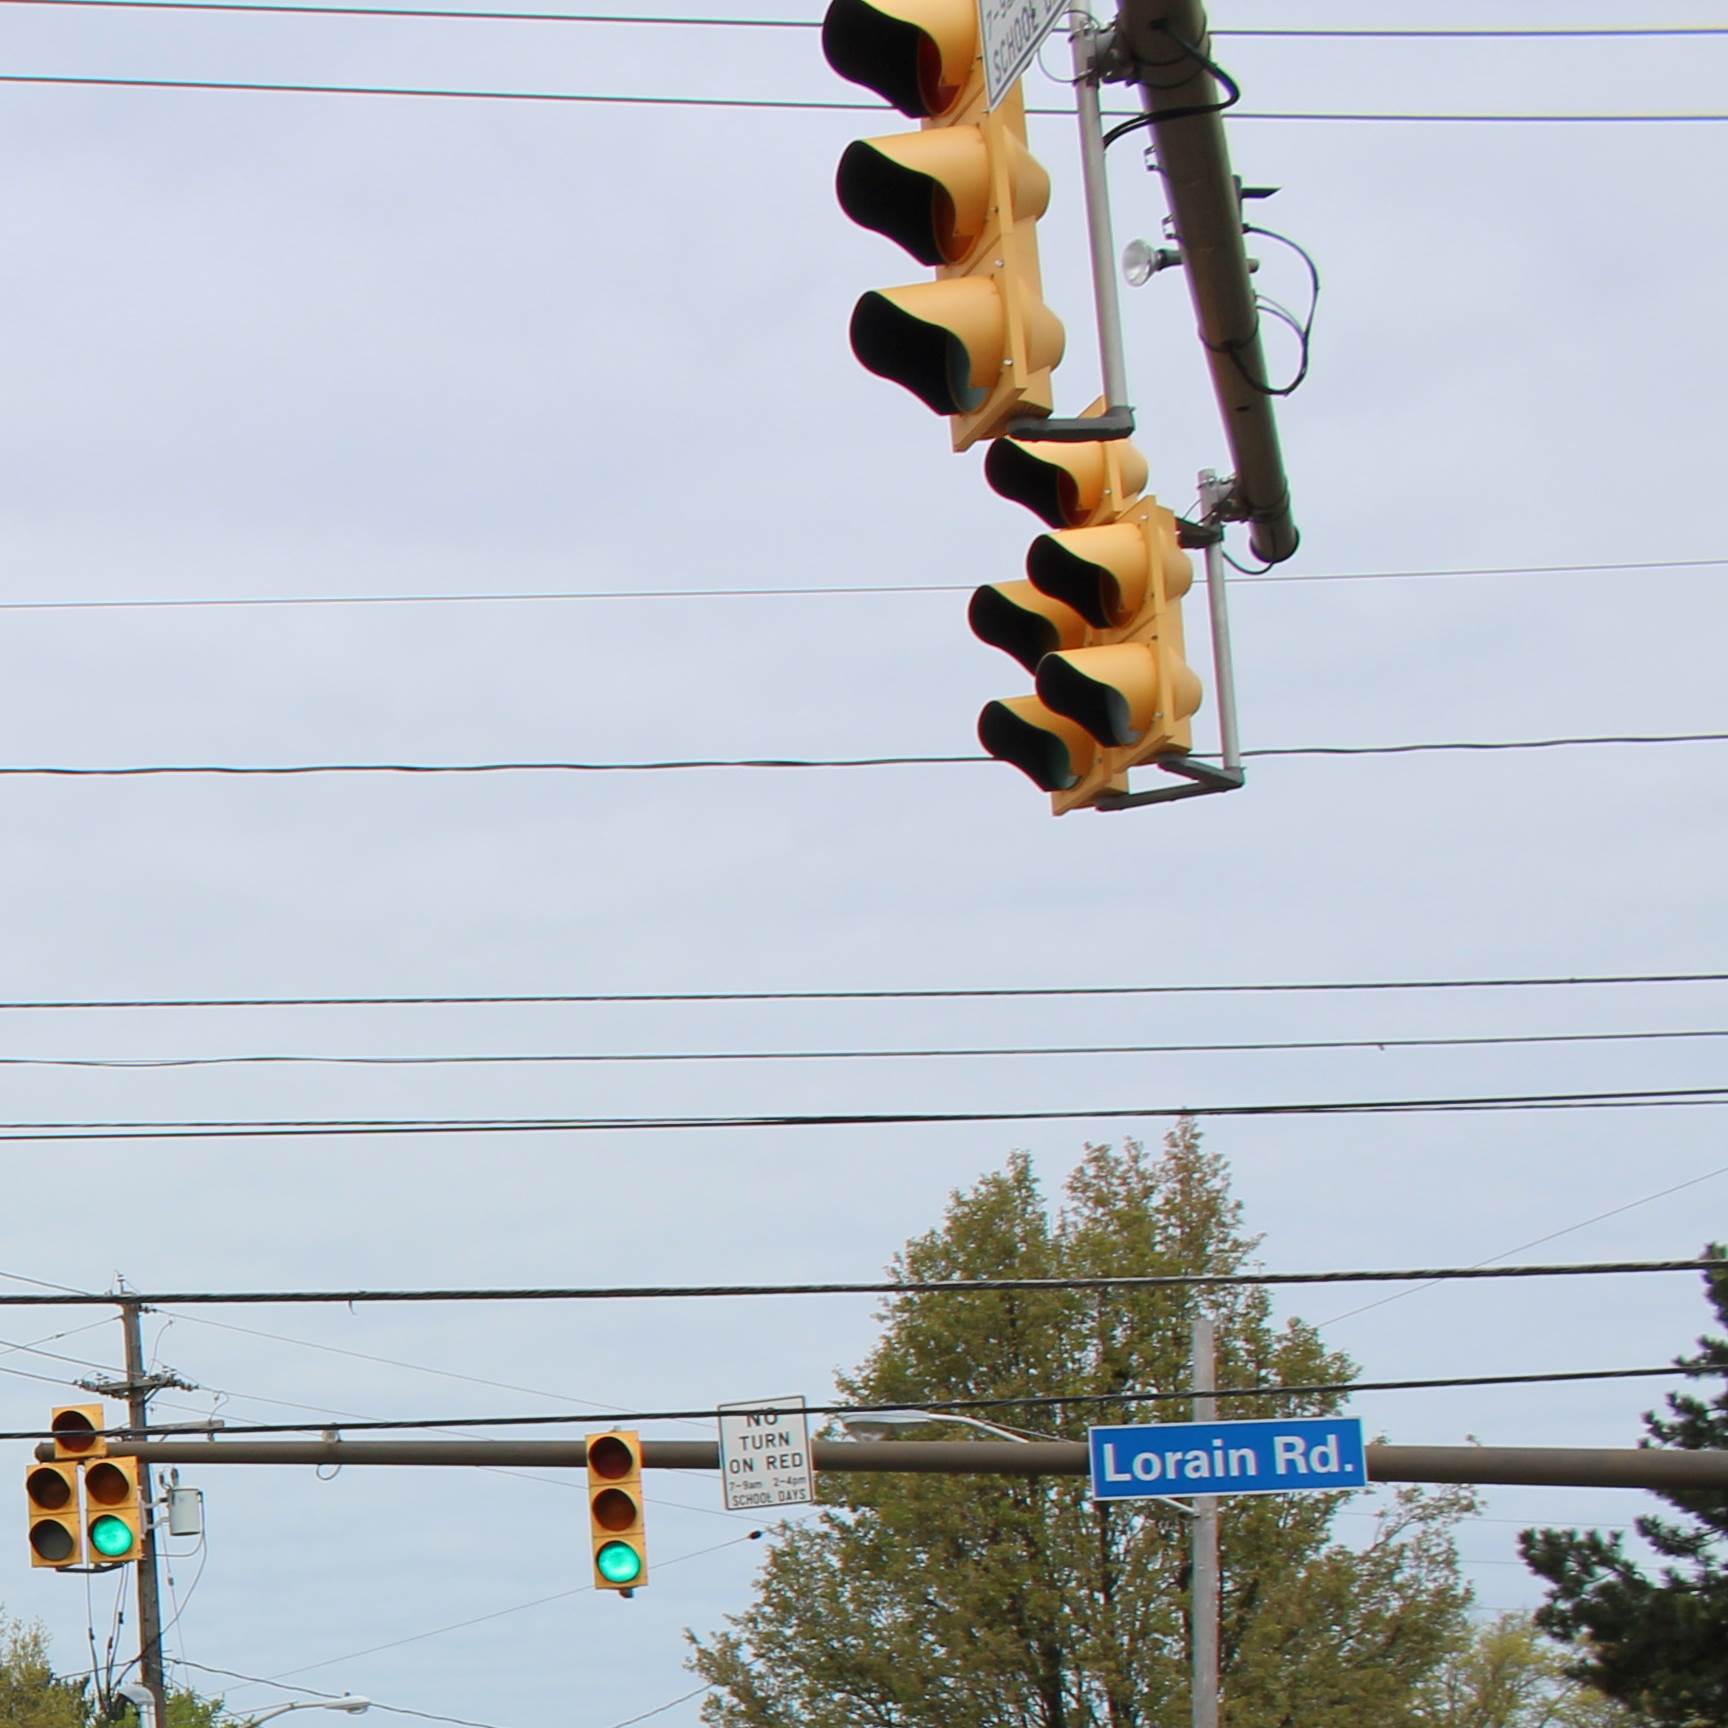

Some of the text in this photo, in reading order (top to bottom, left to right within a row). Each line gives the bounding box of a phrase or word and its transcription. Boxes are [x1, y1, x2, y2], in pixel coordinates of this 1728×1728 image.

[746, 1408, 778, 1427] NO
[738, 1432, 790, 1451] TURN
[729, 1452, 803, 1474] ON RED
[1103, 1434, 1354, 1482] Lorain Rd.
[732, 1488, 806, 1507] SCHOOL DAYS
